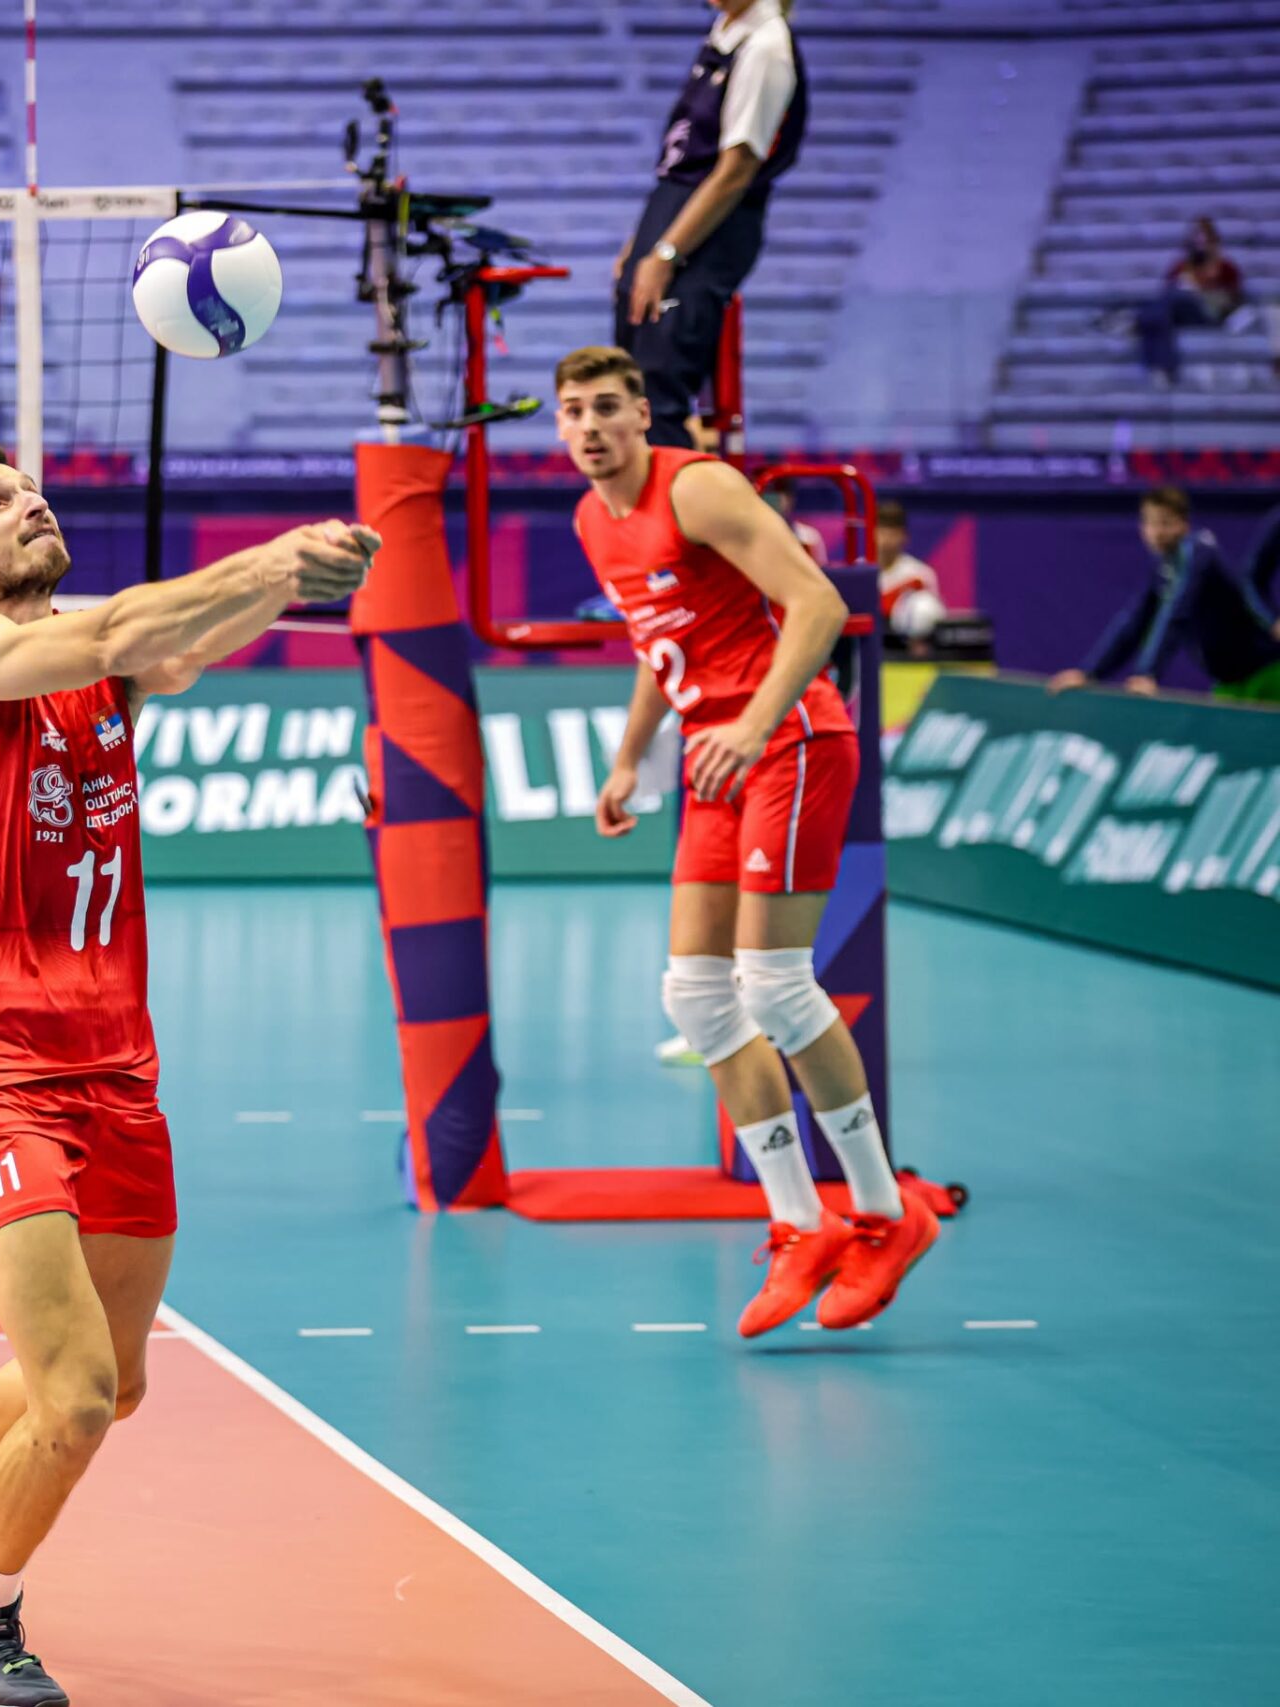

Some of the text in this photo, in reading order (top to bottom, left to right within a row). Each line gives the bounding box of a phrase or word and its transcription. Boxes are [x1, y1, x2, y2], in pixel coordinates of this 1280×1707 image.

[277, 706, 356, 760] IN
[136, 763, 369, 836] ORMA
[35, 830, 64, 843] 1921
[67, 845, 122, 951] 11
